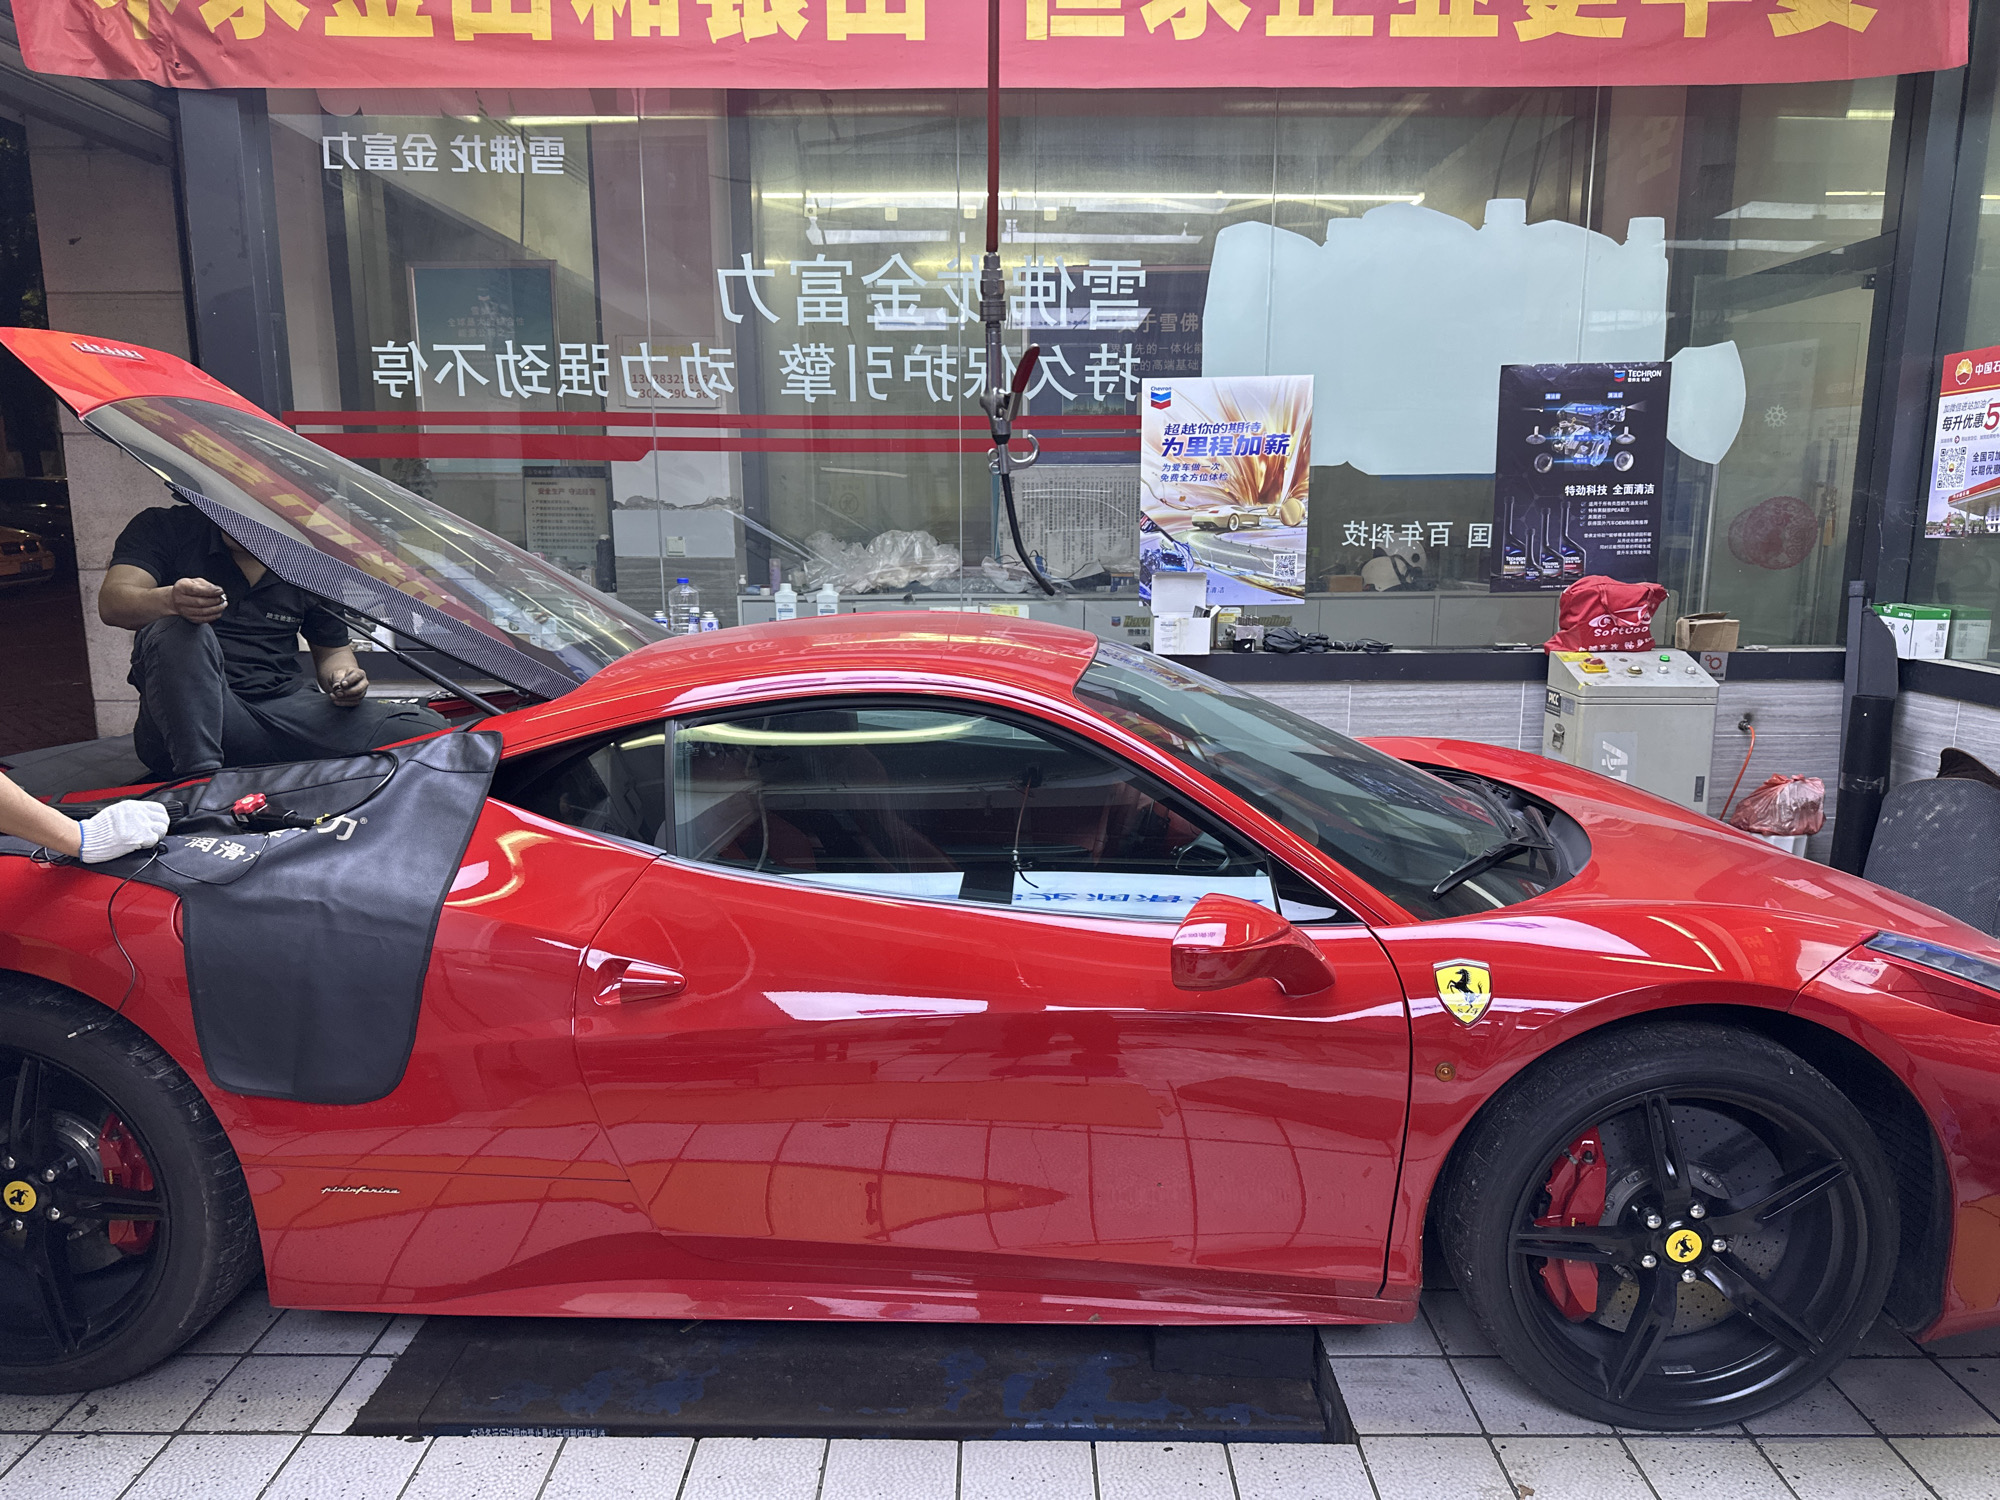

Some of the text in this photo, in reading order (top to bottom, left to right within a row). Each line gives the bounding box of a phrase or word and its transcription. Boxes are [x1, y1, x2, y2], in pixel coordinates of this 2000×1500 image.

[1628, 370, 1662, 379] TECHRON
[1164, 422, 1262, 436] 超越你的期待
[1161, 463, 1221, 472] 为爱车做一次
[1160, 473, 1229, 482] 免费全方位体检
[1564, 484, 1655, 496] 特劲科技 全面清洁
[1548, 692, 1559, 706] PICC
[321, 1186, 400, 1195] pininfarina
